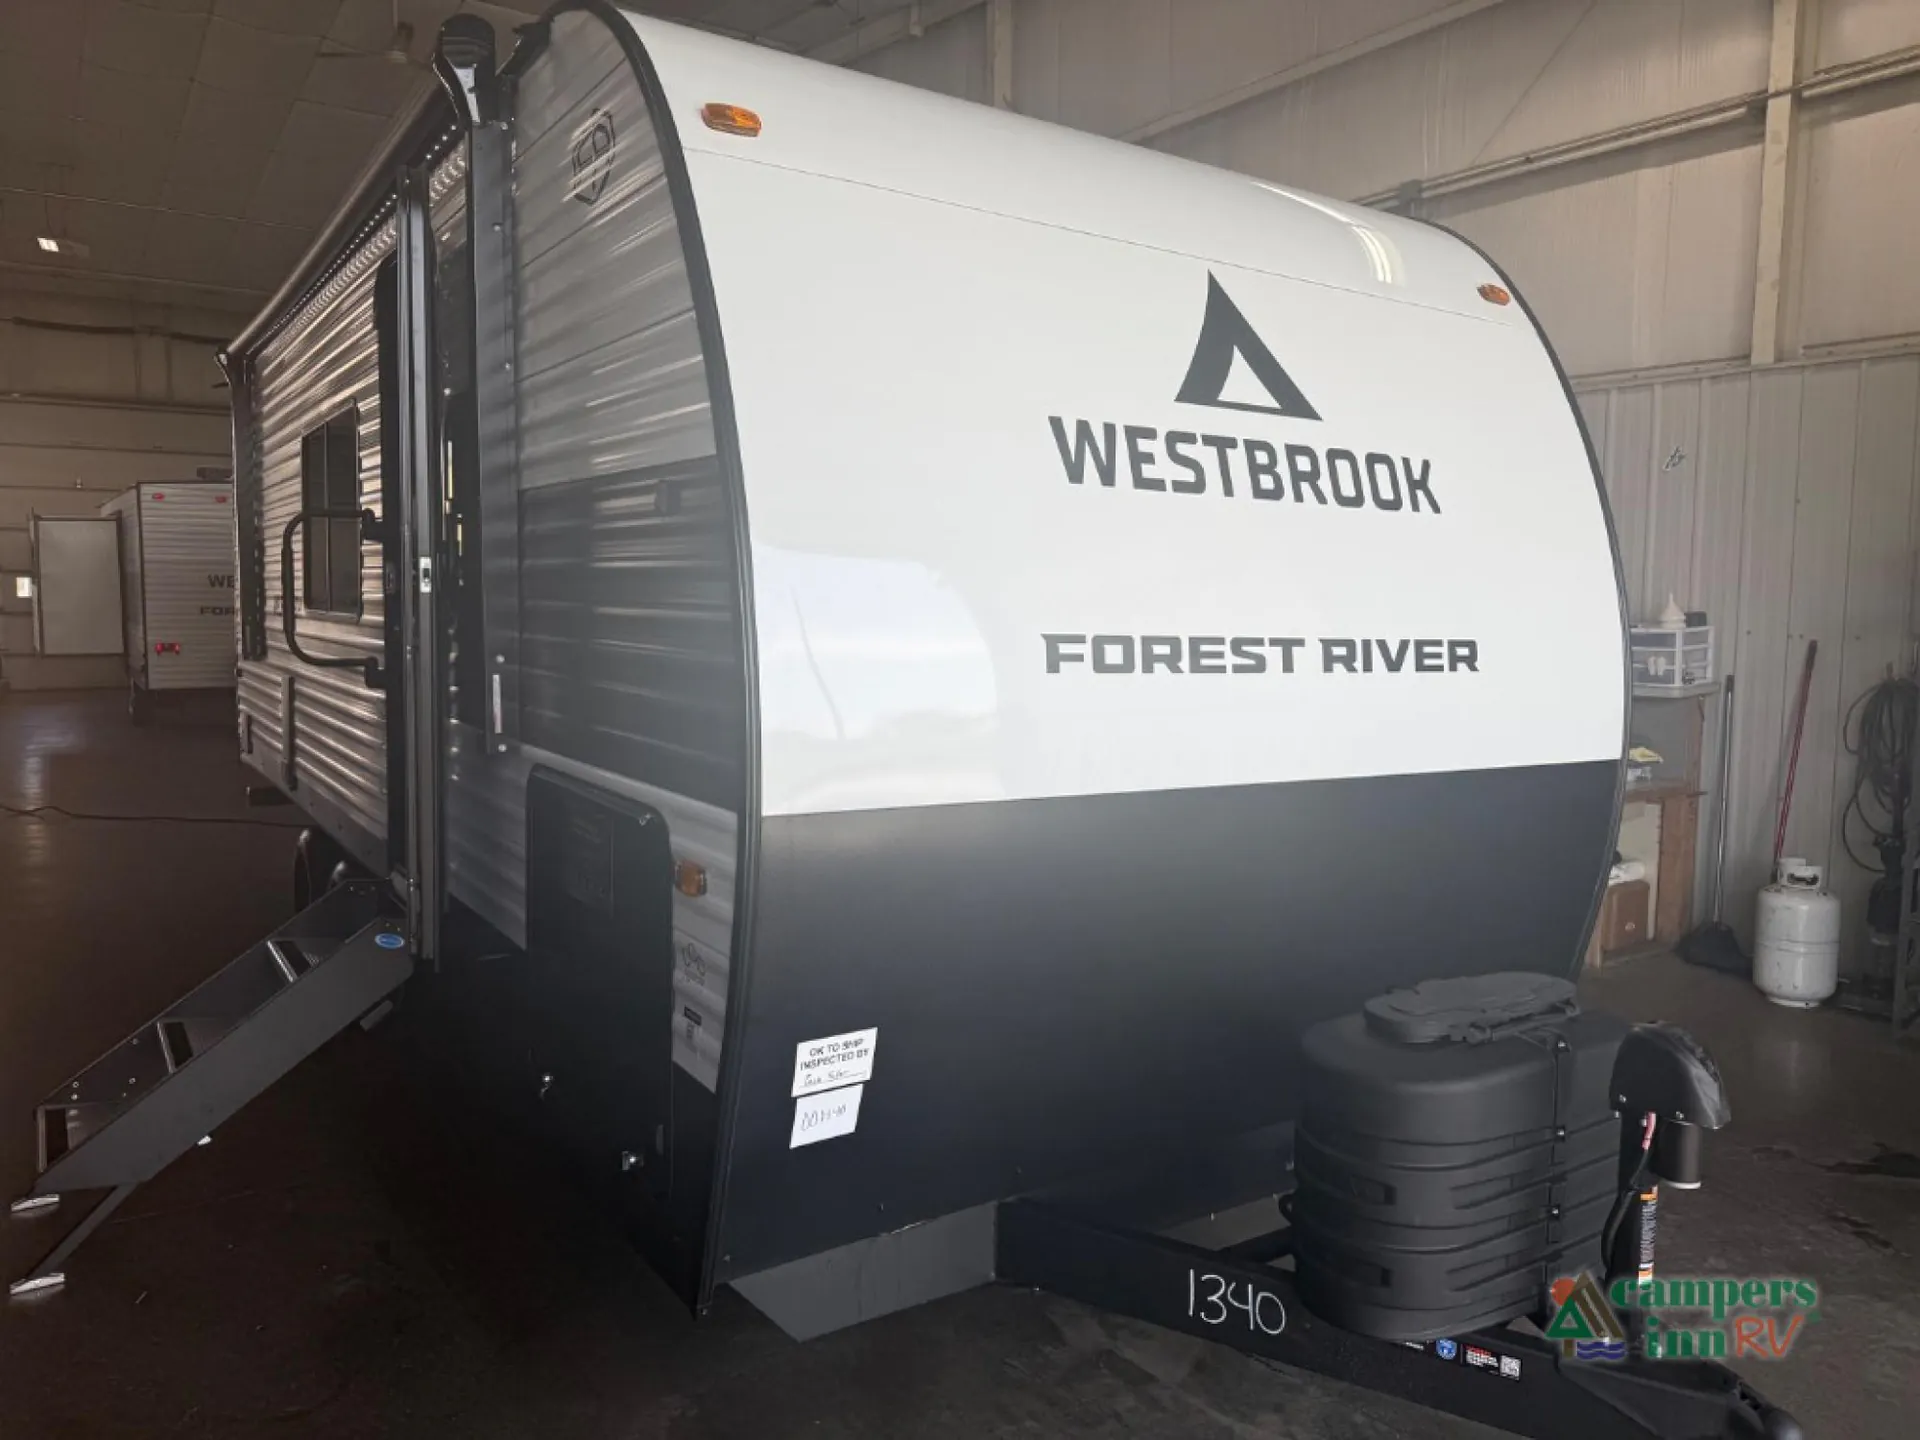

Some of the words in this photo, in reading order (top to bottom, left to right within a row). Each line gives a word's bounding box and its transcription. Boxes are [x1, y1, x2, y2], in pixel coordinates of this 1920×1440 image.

[1047, 415, 1442, 515] WESTBROOK
[1040, 633, 1306, 675] FOREST
[1319, 637, 1480, 673] RIVER
[800, 1051, 855, 1071] INSPECTED
[856, 1048, 869, 1058] BY
[809, 1046, 825, 1057] OK
[827, 1042, 841, 1053] TO
[841, 1038, 864, 1051] SHIP
[1188, 1268, 1287, 1335] 1340
